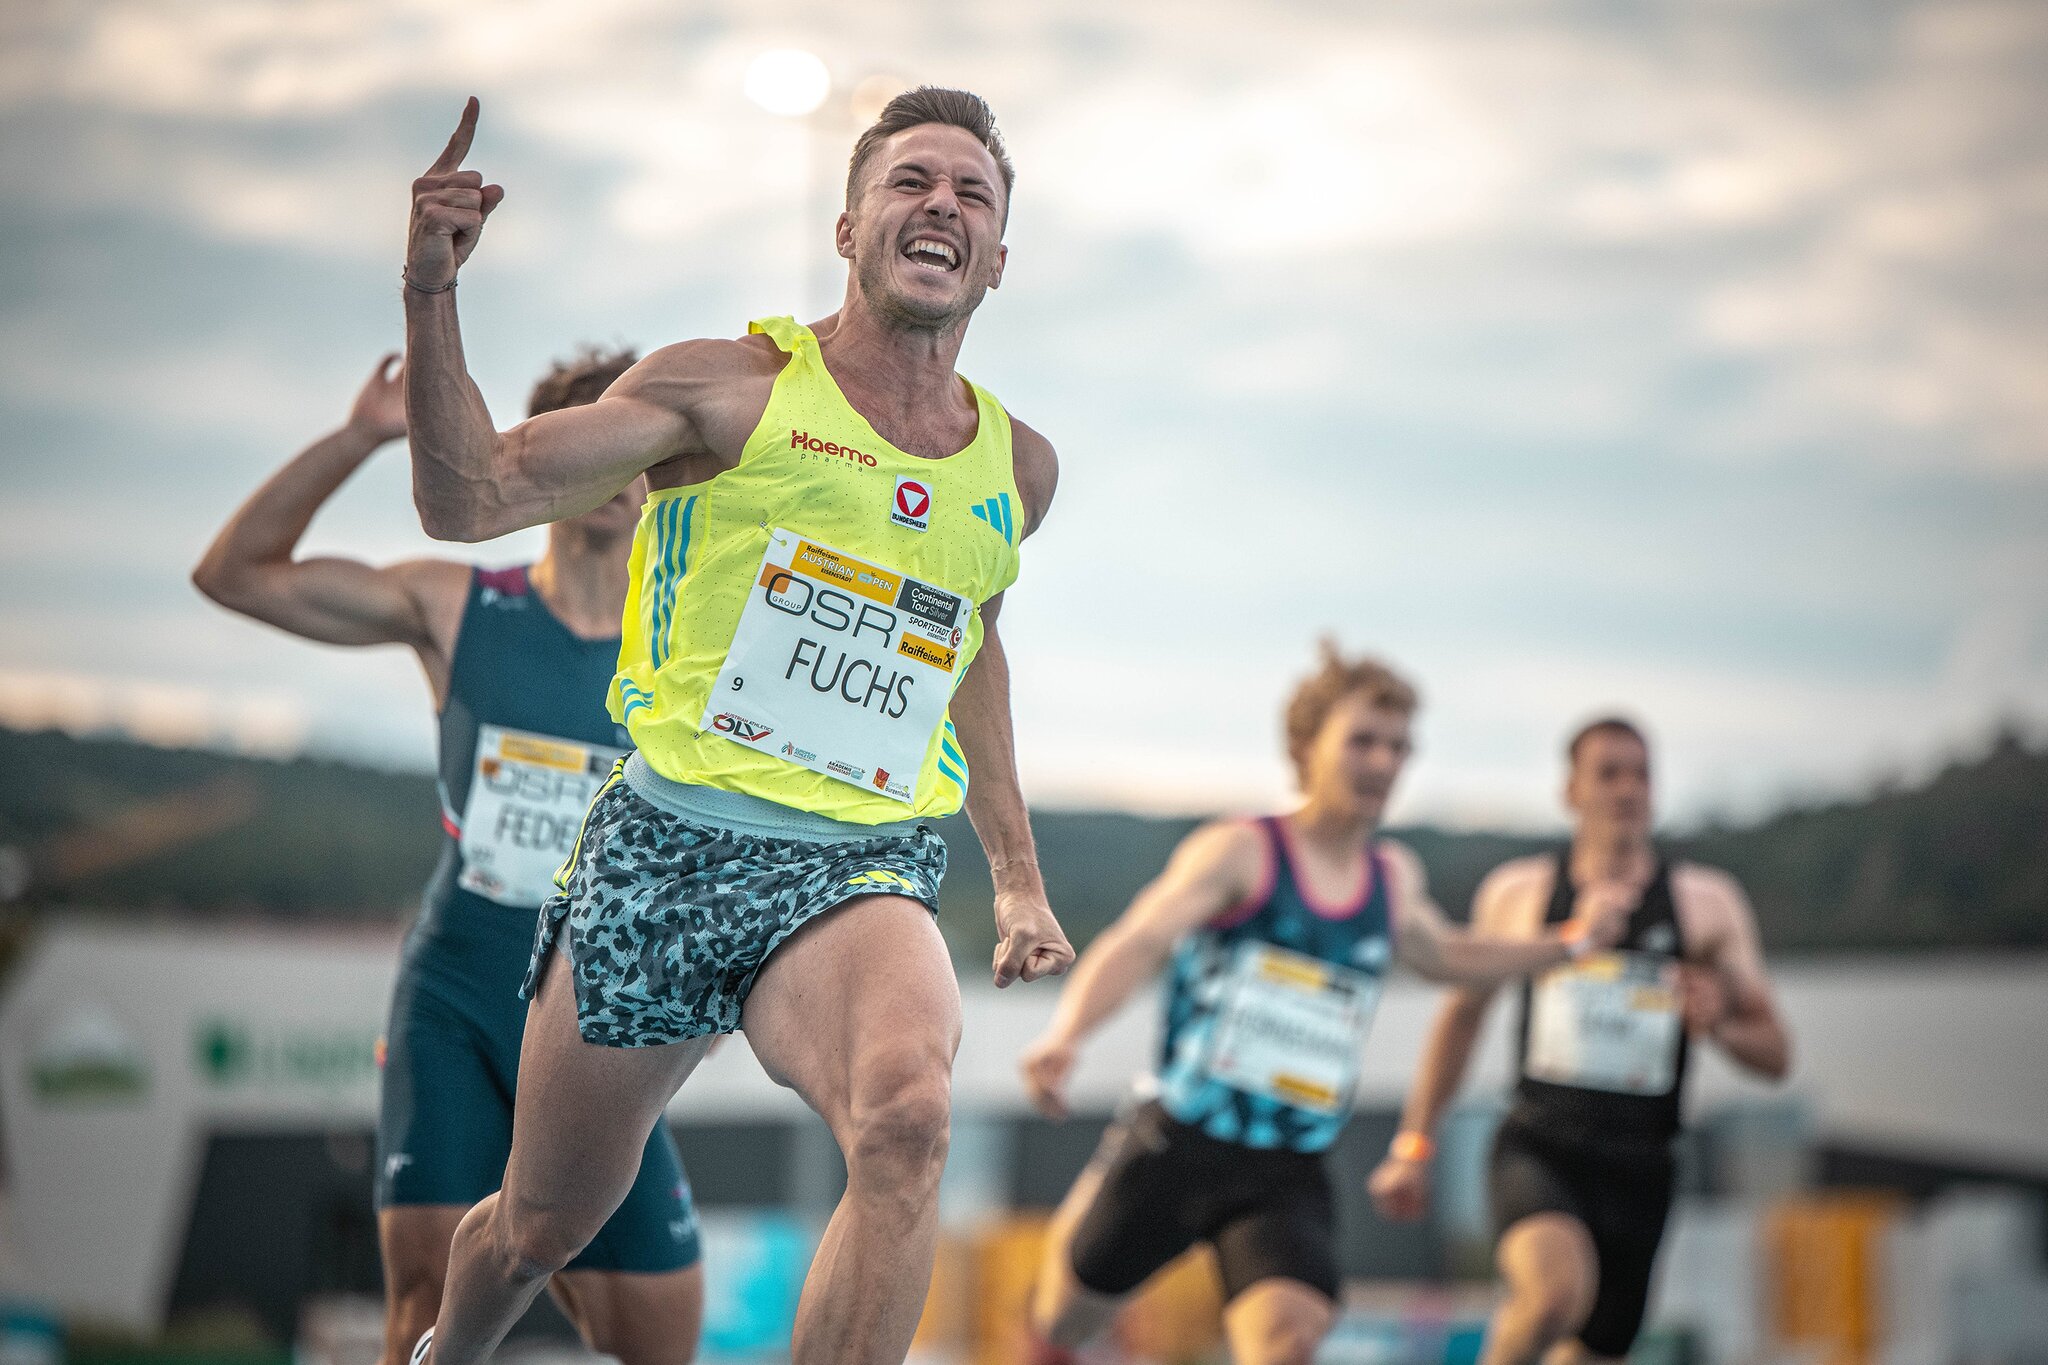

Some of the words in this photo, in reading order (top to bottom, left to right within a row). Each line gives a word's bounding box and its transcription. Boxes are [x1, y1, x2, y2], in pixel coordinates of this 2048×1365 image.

[791, 429, 877, 467] Haemo
[800, 453, 863, 473] pharma
[891, 512, 927, 530] BUNDESHEER
[806, 545, 840, 562] Raiffeisen
[800, 552, 855, 578] AUSTRIAN
[820, 567, 853, 583] EISENSTADT
[765, 572, 897, 649] OSR
[772, 595, 802, 611] GROUP
[911, 588, 955, 612] Continental
[911, 598, 929, 614] Tour
[928, 606, 948, 621] Silver
[908, 616, 950, 637] SPORTSTADT
[900, 641, 943, 666] Raiffeisen
[731, 676, 744, 692] 9
[785, 637, 914, 719] FUCHS
[724, 711, 749, 723] AUSTRIAN
